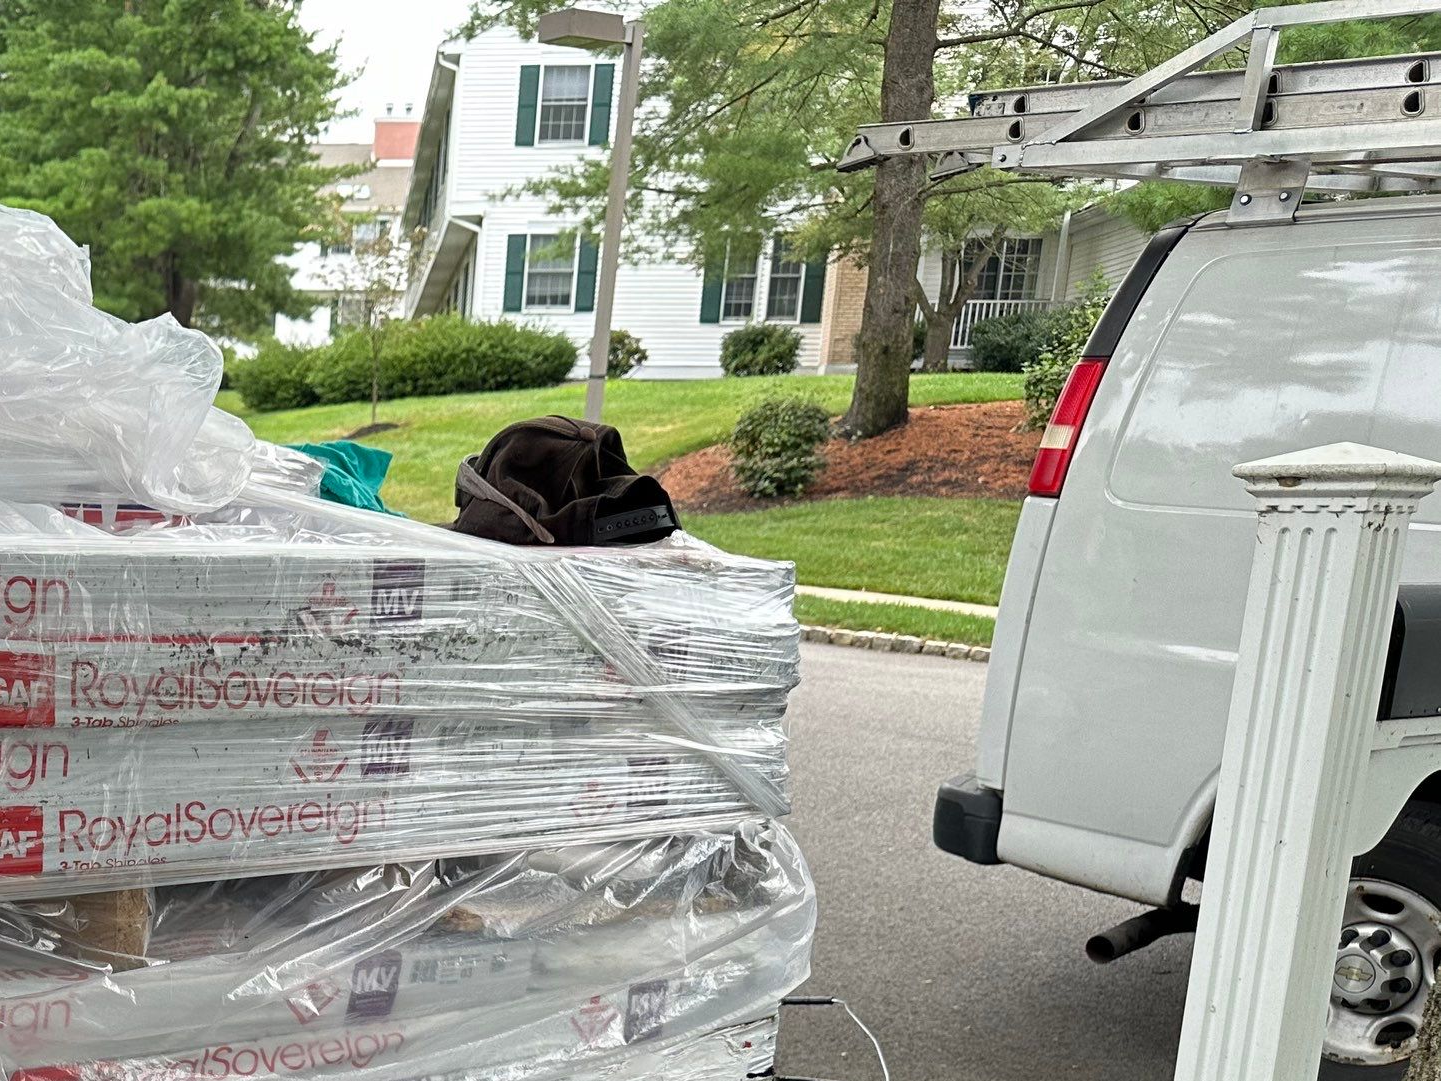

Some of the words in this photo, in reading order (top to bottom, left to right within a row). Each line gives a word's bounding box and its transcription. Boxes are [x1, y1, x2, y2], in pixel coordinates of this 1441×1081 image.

[374, 589, 422, 616] MV
[71, 658, 401, 716] RoyalSovereign
[58, 797, 387, 856] RoyalSovereign
[360, 966, 397, 994] MV
